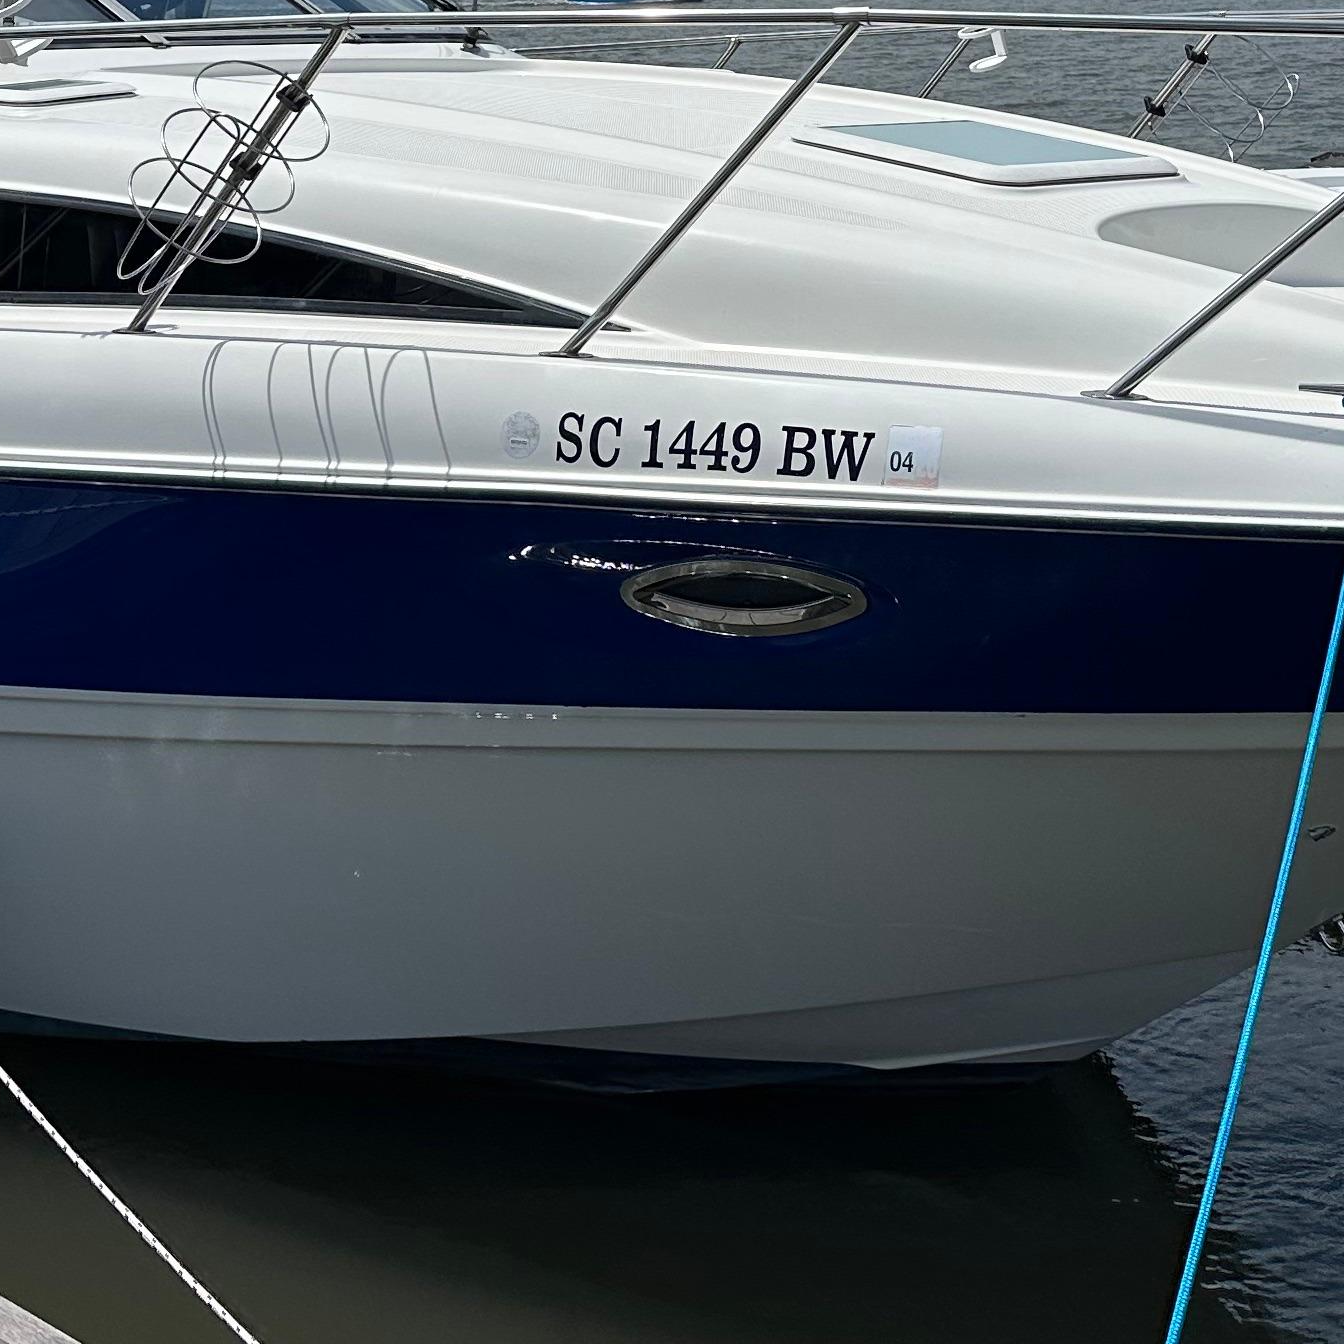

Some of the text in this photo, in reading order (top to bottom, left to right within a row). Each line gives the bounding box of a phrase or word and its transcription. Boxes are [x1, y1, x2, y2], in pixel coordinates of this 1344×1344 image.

[555, 411, 877, 482] SC 1449 BW
[889, 450, 914, 473] 04
